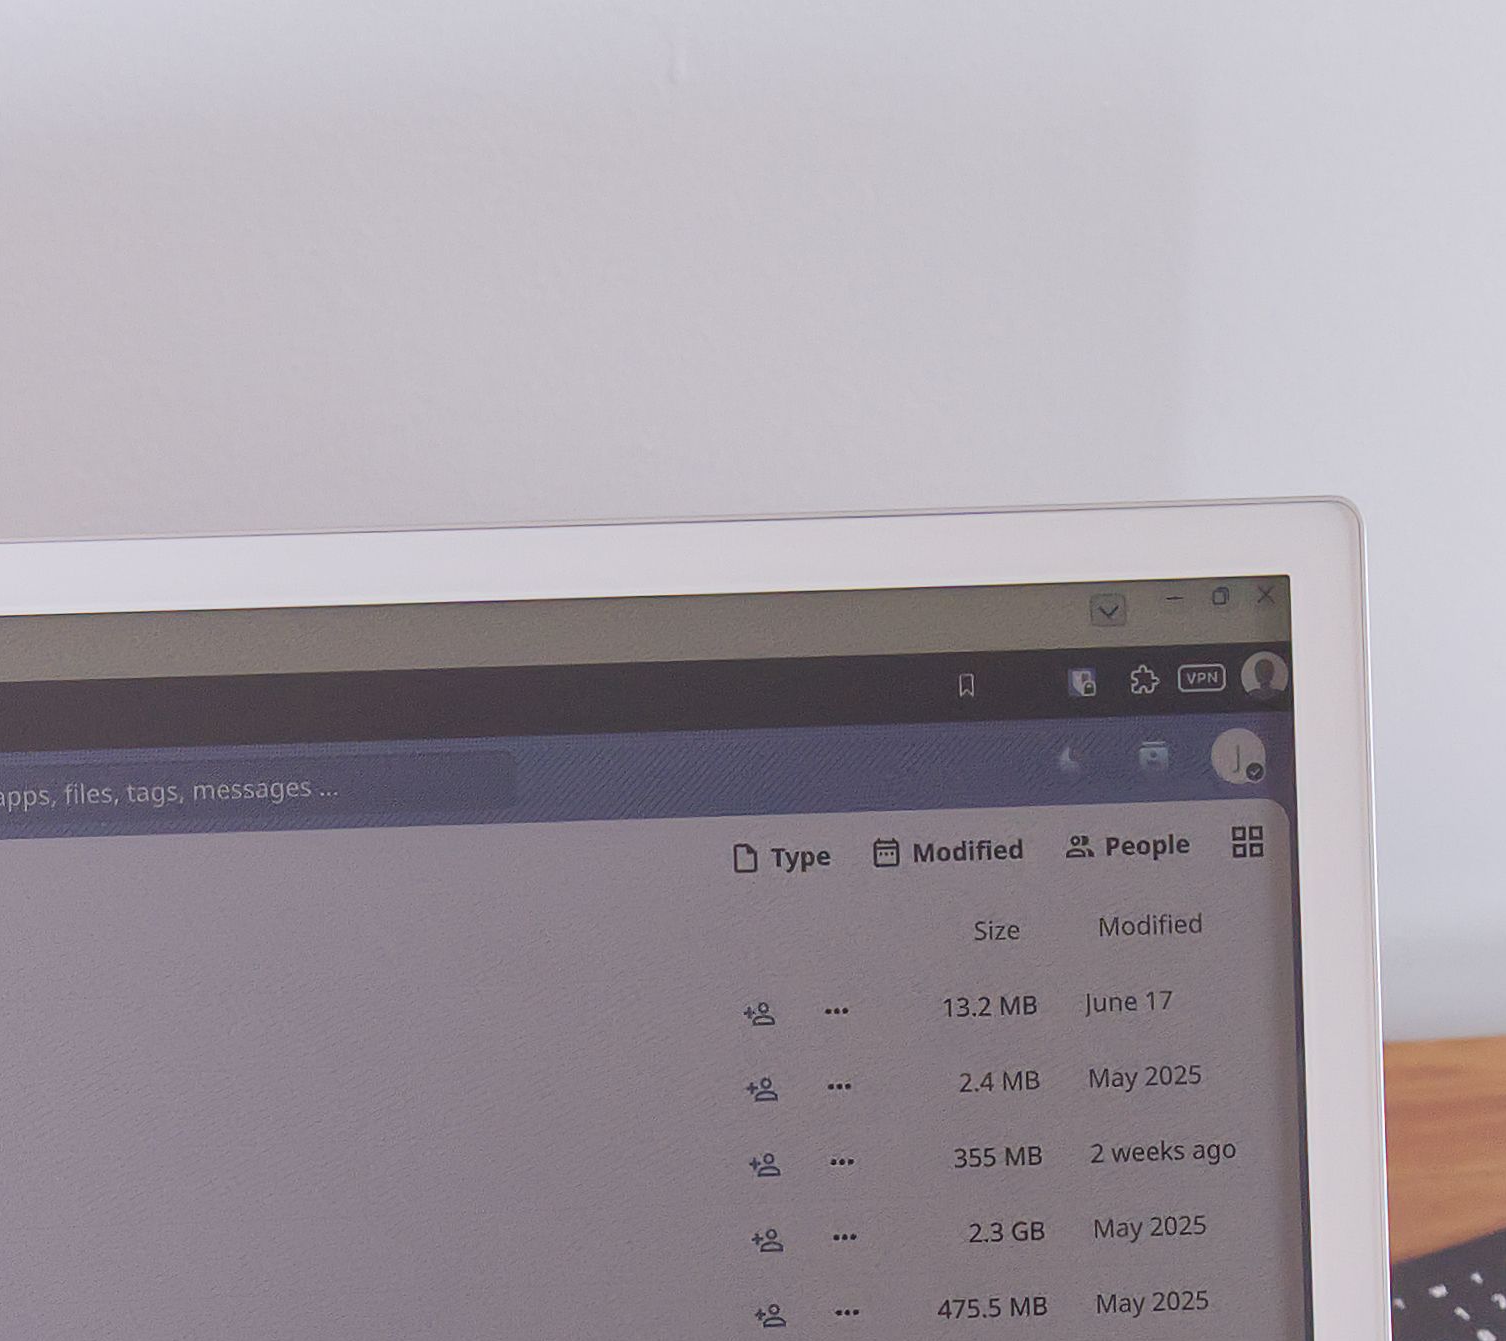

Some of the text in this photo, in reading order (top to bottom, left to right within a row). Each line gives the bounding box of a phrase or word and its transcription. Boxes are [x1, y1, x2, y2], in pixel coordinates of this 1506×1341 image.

[1186, 671, 1218, 685] VPN
[63, 782, 119, 806] files,
[126, 784, 184, 808] tags,
[193, 781, 312, 805] messages
[913, 838, 1024, 863] Modified
[1105, 833, 1190, 861] People
[770, 847, 831, 874] Type
[974, 920, 1020, 942] Size
[1099, 912, 1203, 937] Modified
[943, 995, 1038, 1018] 13.2 MB
[1085, 990, 1173, 1018] June 17
[954, 1145, 1043, 1169] 355 MB
[1090, 1140, 1237, 1166] 2 weeks ago
[969, 1220, 1045, 1244] 2.3 GB
[1094, 1214, 1207, 1244] May 2025
[937, 1296, 1048, 1320] 475.5 MB
[1096, 1289, 1209, 1319] May 2025
